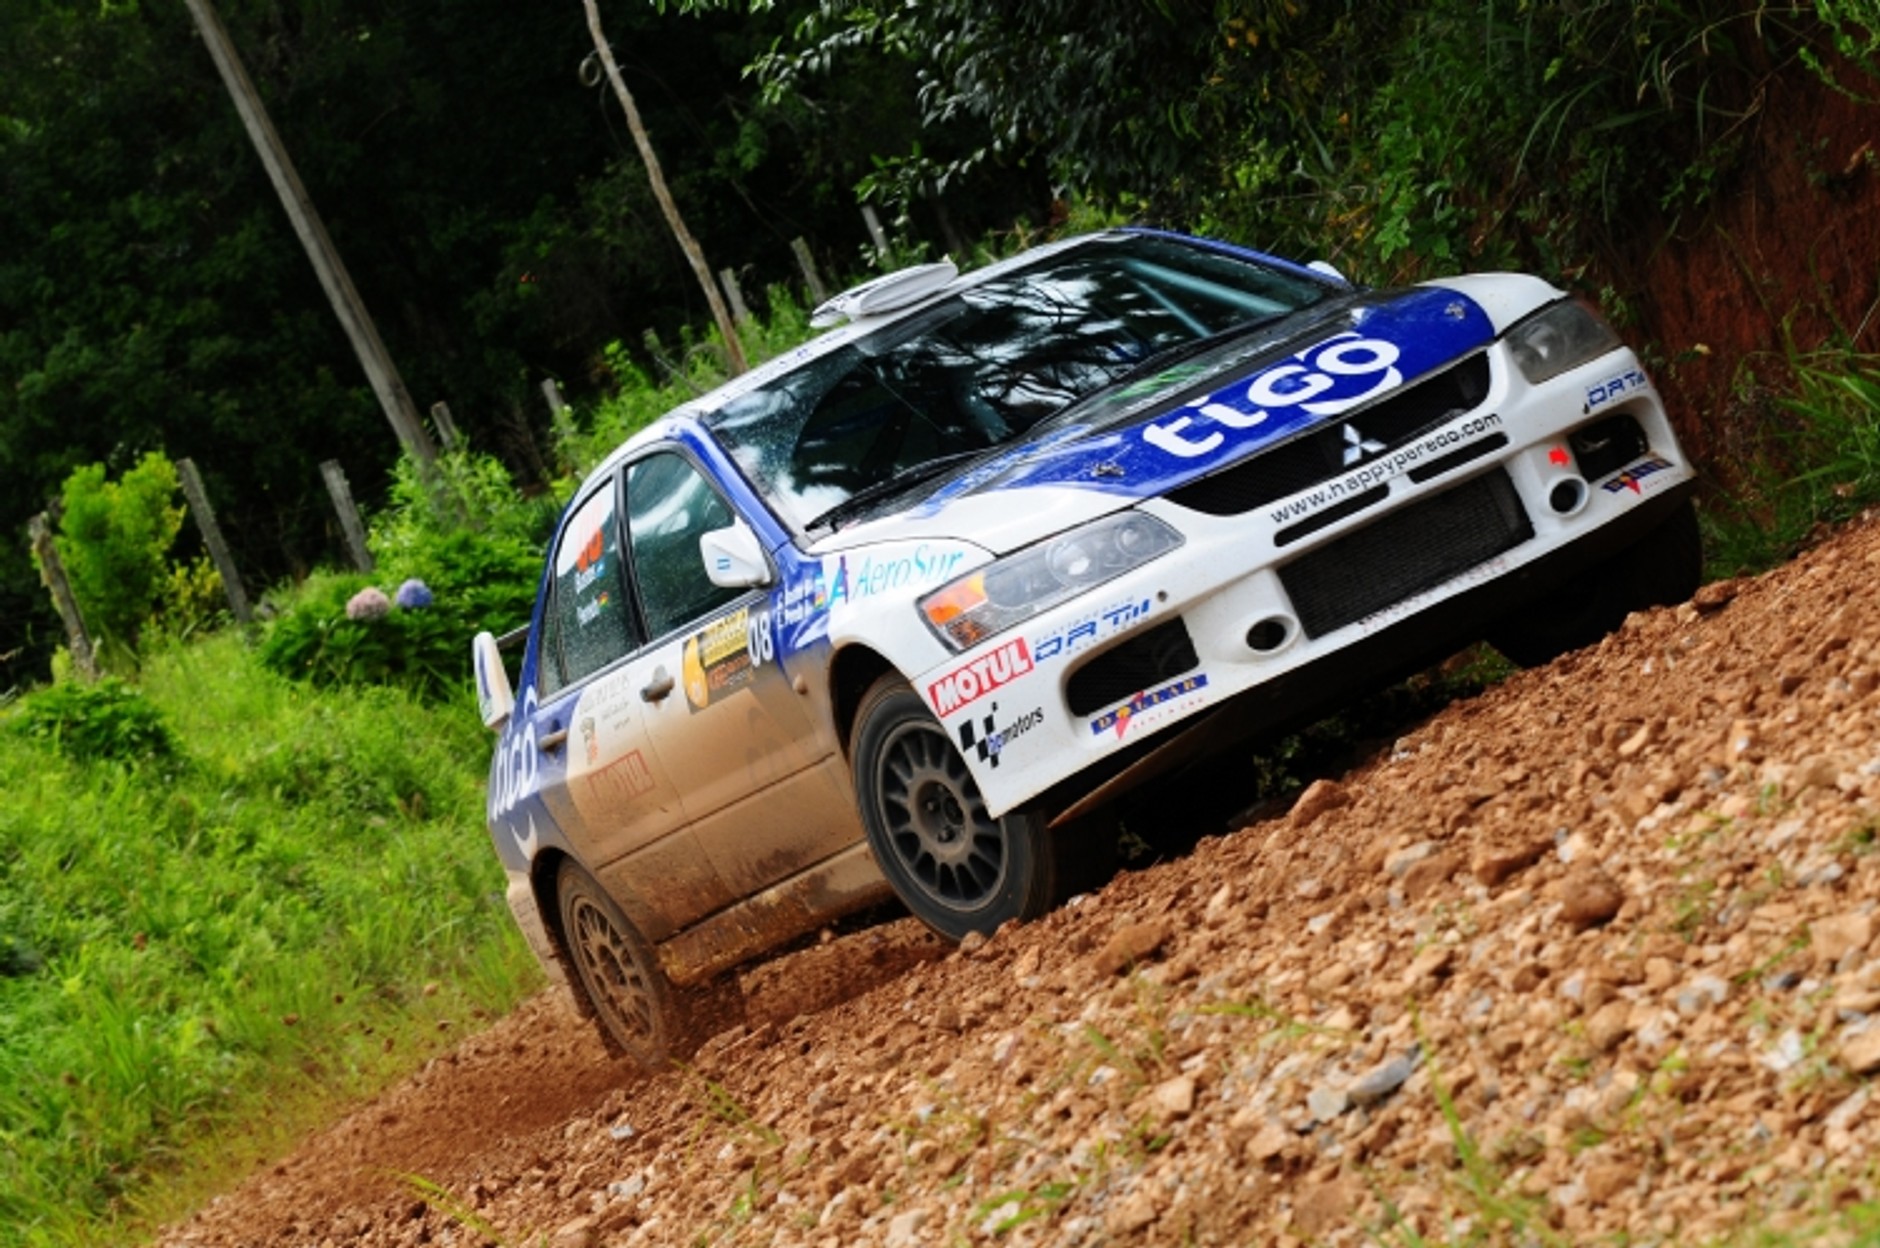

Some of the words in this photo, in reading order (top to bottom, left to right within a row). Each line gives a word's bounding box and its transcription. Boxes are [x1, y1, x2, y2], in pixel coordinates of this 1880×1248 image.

[851, 544, 963, 600] AeroSur
[748, 611, 774, 668] 08
[934, 642, 1031, 715] MOTUL
